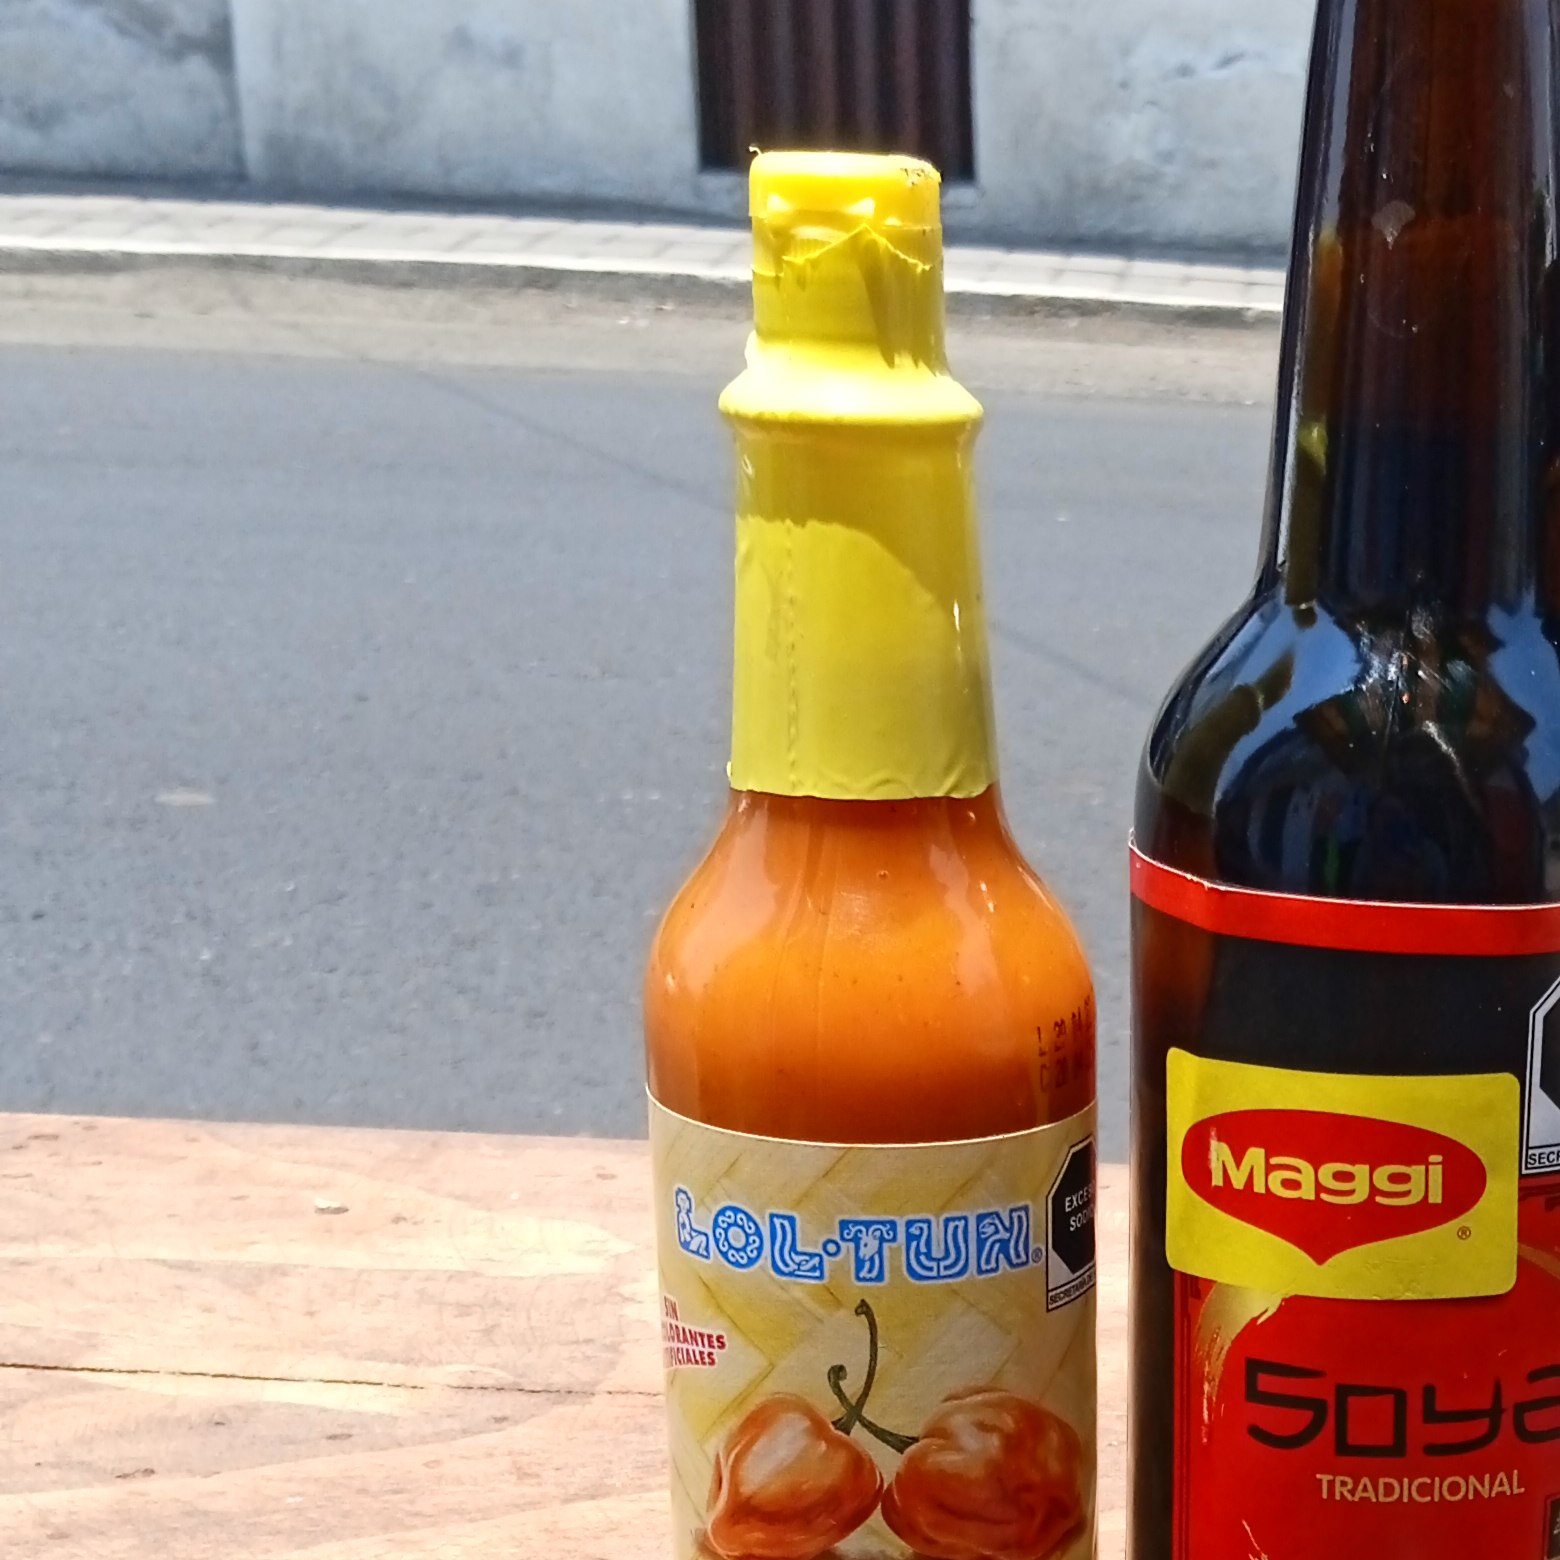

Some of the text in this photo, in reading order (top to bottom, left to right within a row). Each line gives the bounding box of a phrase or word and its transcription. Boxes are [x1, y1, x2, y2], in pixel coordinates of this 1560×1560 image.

[1210, 1141, 1443, 1206] Maggi
[1065, 1184, 1095, 1212] EXCE
[1070, 1203, 1095, 1232] SOD
[1316, 1469, 1525, 1503] TRADICIONAL
